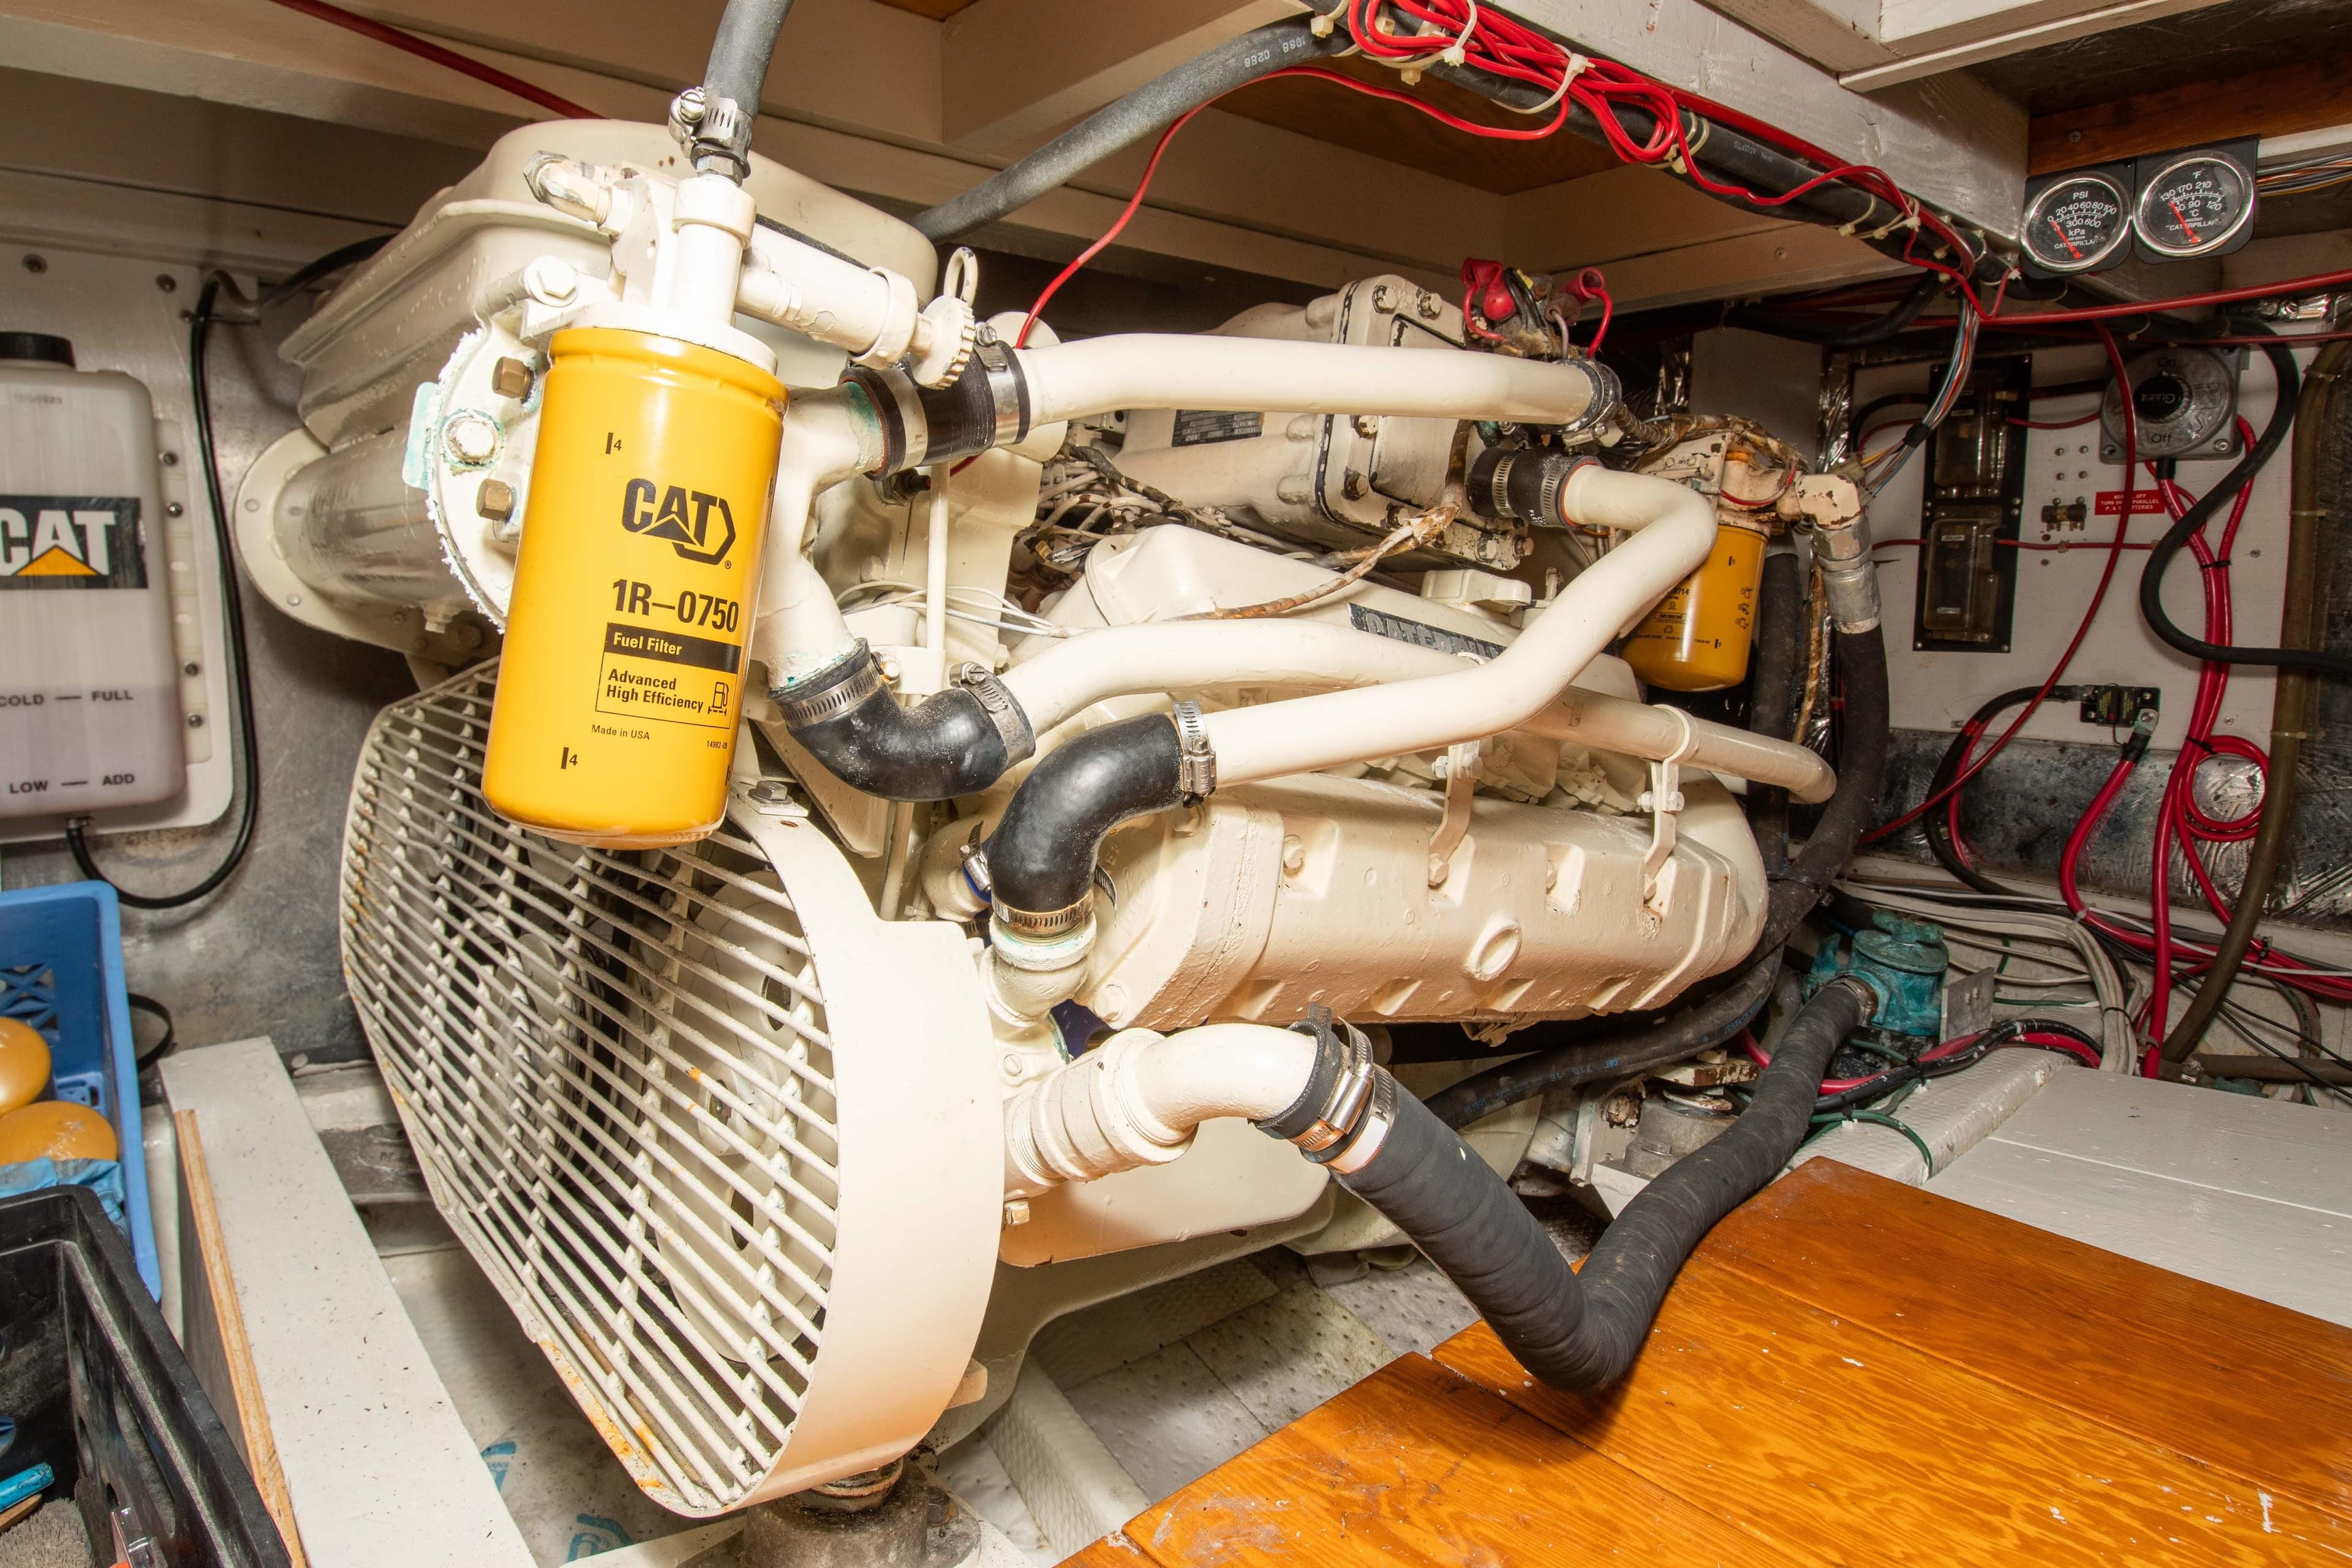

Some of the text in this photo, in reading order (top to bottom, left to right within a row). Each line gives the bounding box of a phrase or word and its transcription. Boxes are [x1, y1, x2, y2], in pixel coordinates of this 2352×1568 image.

[2073, 191, 2089, 200] PSI
[2160, 181, 2212, 202] 130 170 210
[2056, 206, 2067, 216] 20
[2103, 204, 2117, 214] 100
[2188, 200, 2201, 209] 90
[2206, 201, 2222, 211] 120
[2066, 219, 2083, 228] 300
[2084, 218, 2101, 228] 600
[2068, 228, 2086, 236] kPa
[2151, 433, 2172, 443] Off
[622, 478, 718, 548] CAT
[0, 508, 116, 576] CAT
[613, 631, 682, 655] Fuel Filter
[608, 668, 677, 690] Advanced
[0, 690, 134, 707] COLD FULL
[606, 684, 704, 713] High Efficiency
[591, 724, 650, 740] Made in USA
[9, 773, 135, 794] LOW ADD
